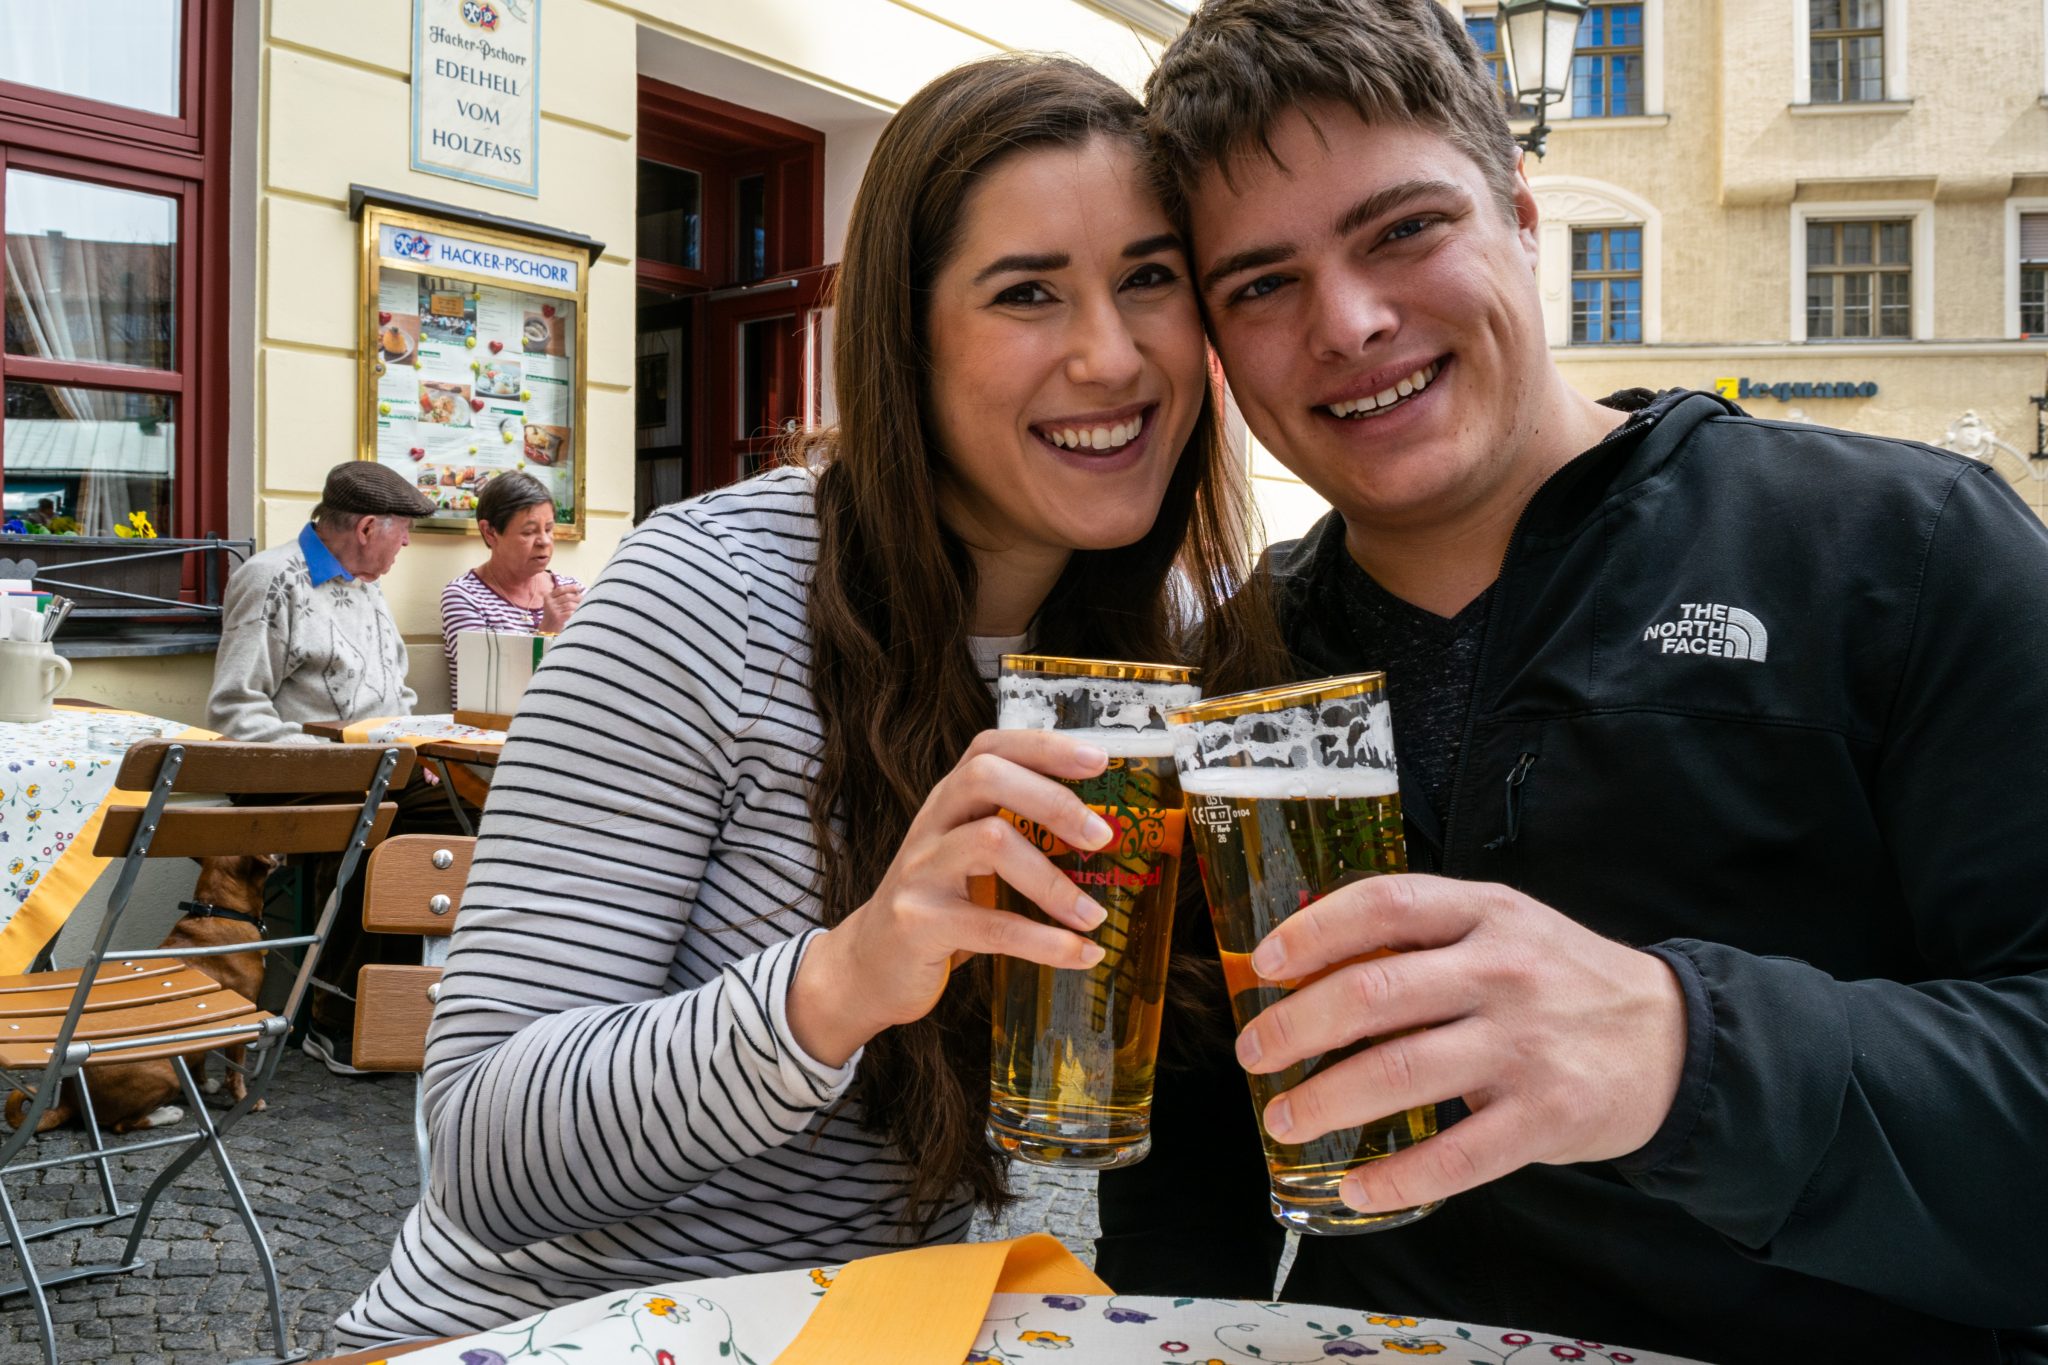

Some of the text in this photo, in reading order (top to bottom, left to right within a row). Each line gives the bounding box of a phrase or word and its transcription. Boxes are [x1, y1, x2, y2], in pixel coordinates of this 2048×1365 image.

[429, 25, 527, 66] Hacker-Pschorr
[435, 58, 520, 97] EDELHELL
[456, 99, 500, 126] VOM
[432, 128, 522, 165] HOLZFASS
[441, 243, 569, 283] HACKER-PSCHORR
[1680, 603, 1729, 621] THE
[1642, 620, 1726, 641] NORTH
[1661, 637, 1724, 657] FACE
[1218, 811, 1226, 820] 17
[1232, 808, 1251, 818] 0104
